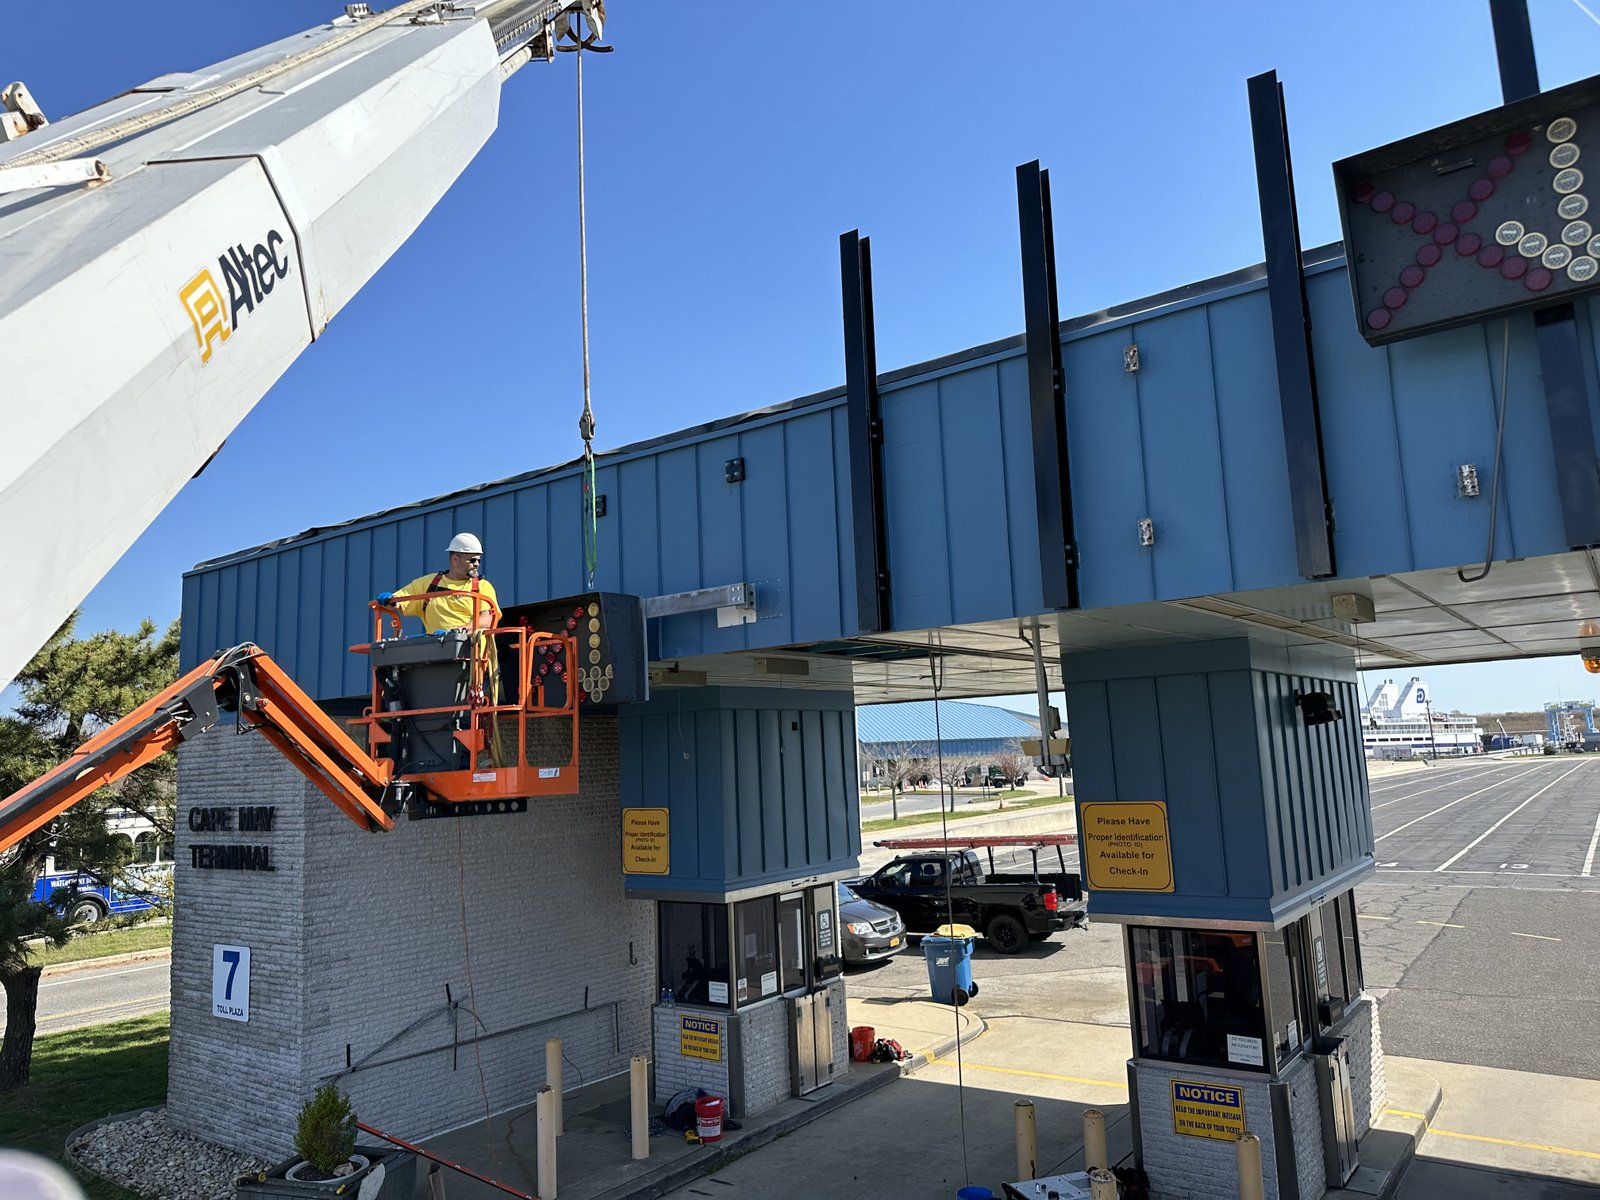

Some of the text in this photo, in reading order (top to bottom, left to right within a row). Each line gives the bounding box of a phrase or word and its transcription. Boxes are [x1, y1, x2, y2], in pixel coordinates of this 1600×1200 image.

[218, 229, 289, 331] Altec
[188, 805, 276, 833] CAPE MAY
[1097, 817, 1151, 826] Please Have
[1088, 833, 1164, 842] Proper Identification
[188, 844, 275, 872] TERMINAL
[1100, 851, 1155, 859] Available for
[1109, 866, 1149, 876] Check-In
[222, 950, 240, 1001] 7
[216, 1004, 244, 1017] TOLL PLAZA
[685, 1020, 716, 1032] NOTICE
[1179, 1086, 1235, 1104] NOTICE
[1176, 1105, 1188, 1113] READ
[1196, 1108, 1221, 1118] IMPORTANT
[1222, 1111, 1242, 1121] MESSAGE
[1195, 1121, 1206, 1129] BACK
[1213, 1124, 1225, 1132] YOUR
